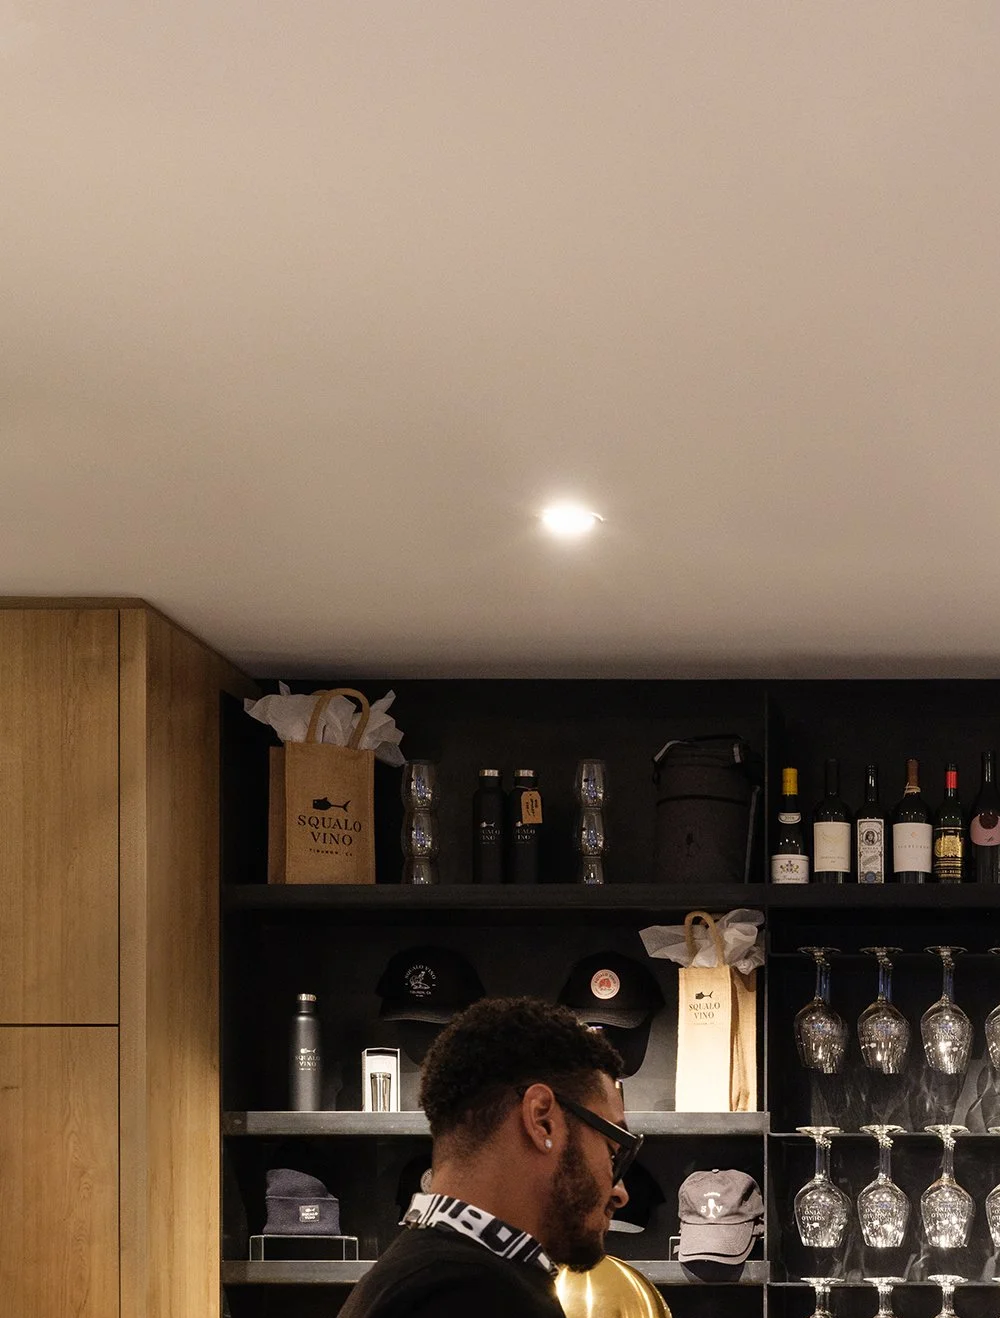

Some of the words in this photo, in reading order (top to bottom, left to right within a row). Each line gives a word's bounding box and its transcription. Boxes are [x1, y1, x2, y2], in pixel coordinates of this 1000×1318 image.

[297, 814, 362, 833] SQUALO
[310, 831, 353, 846] VINO
[689, 1001, 721, 1011] SQUALO
[694, 1011, 715, 1019] VINO
[700, 1205, 707, 1213] S
[716, 1205, 723, 1213] V
